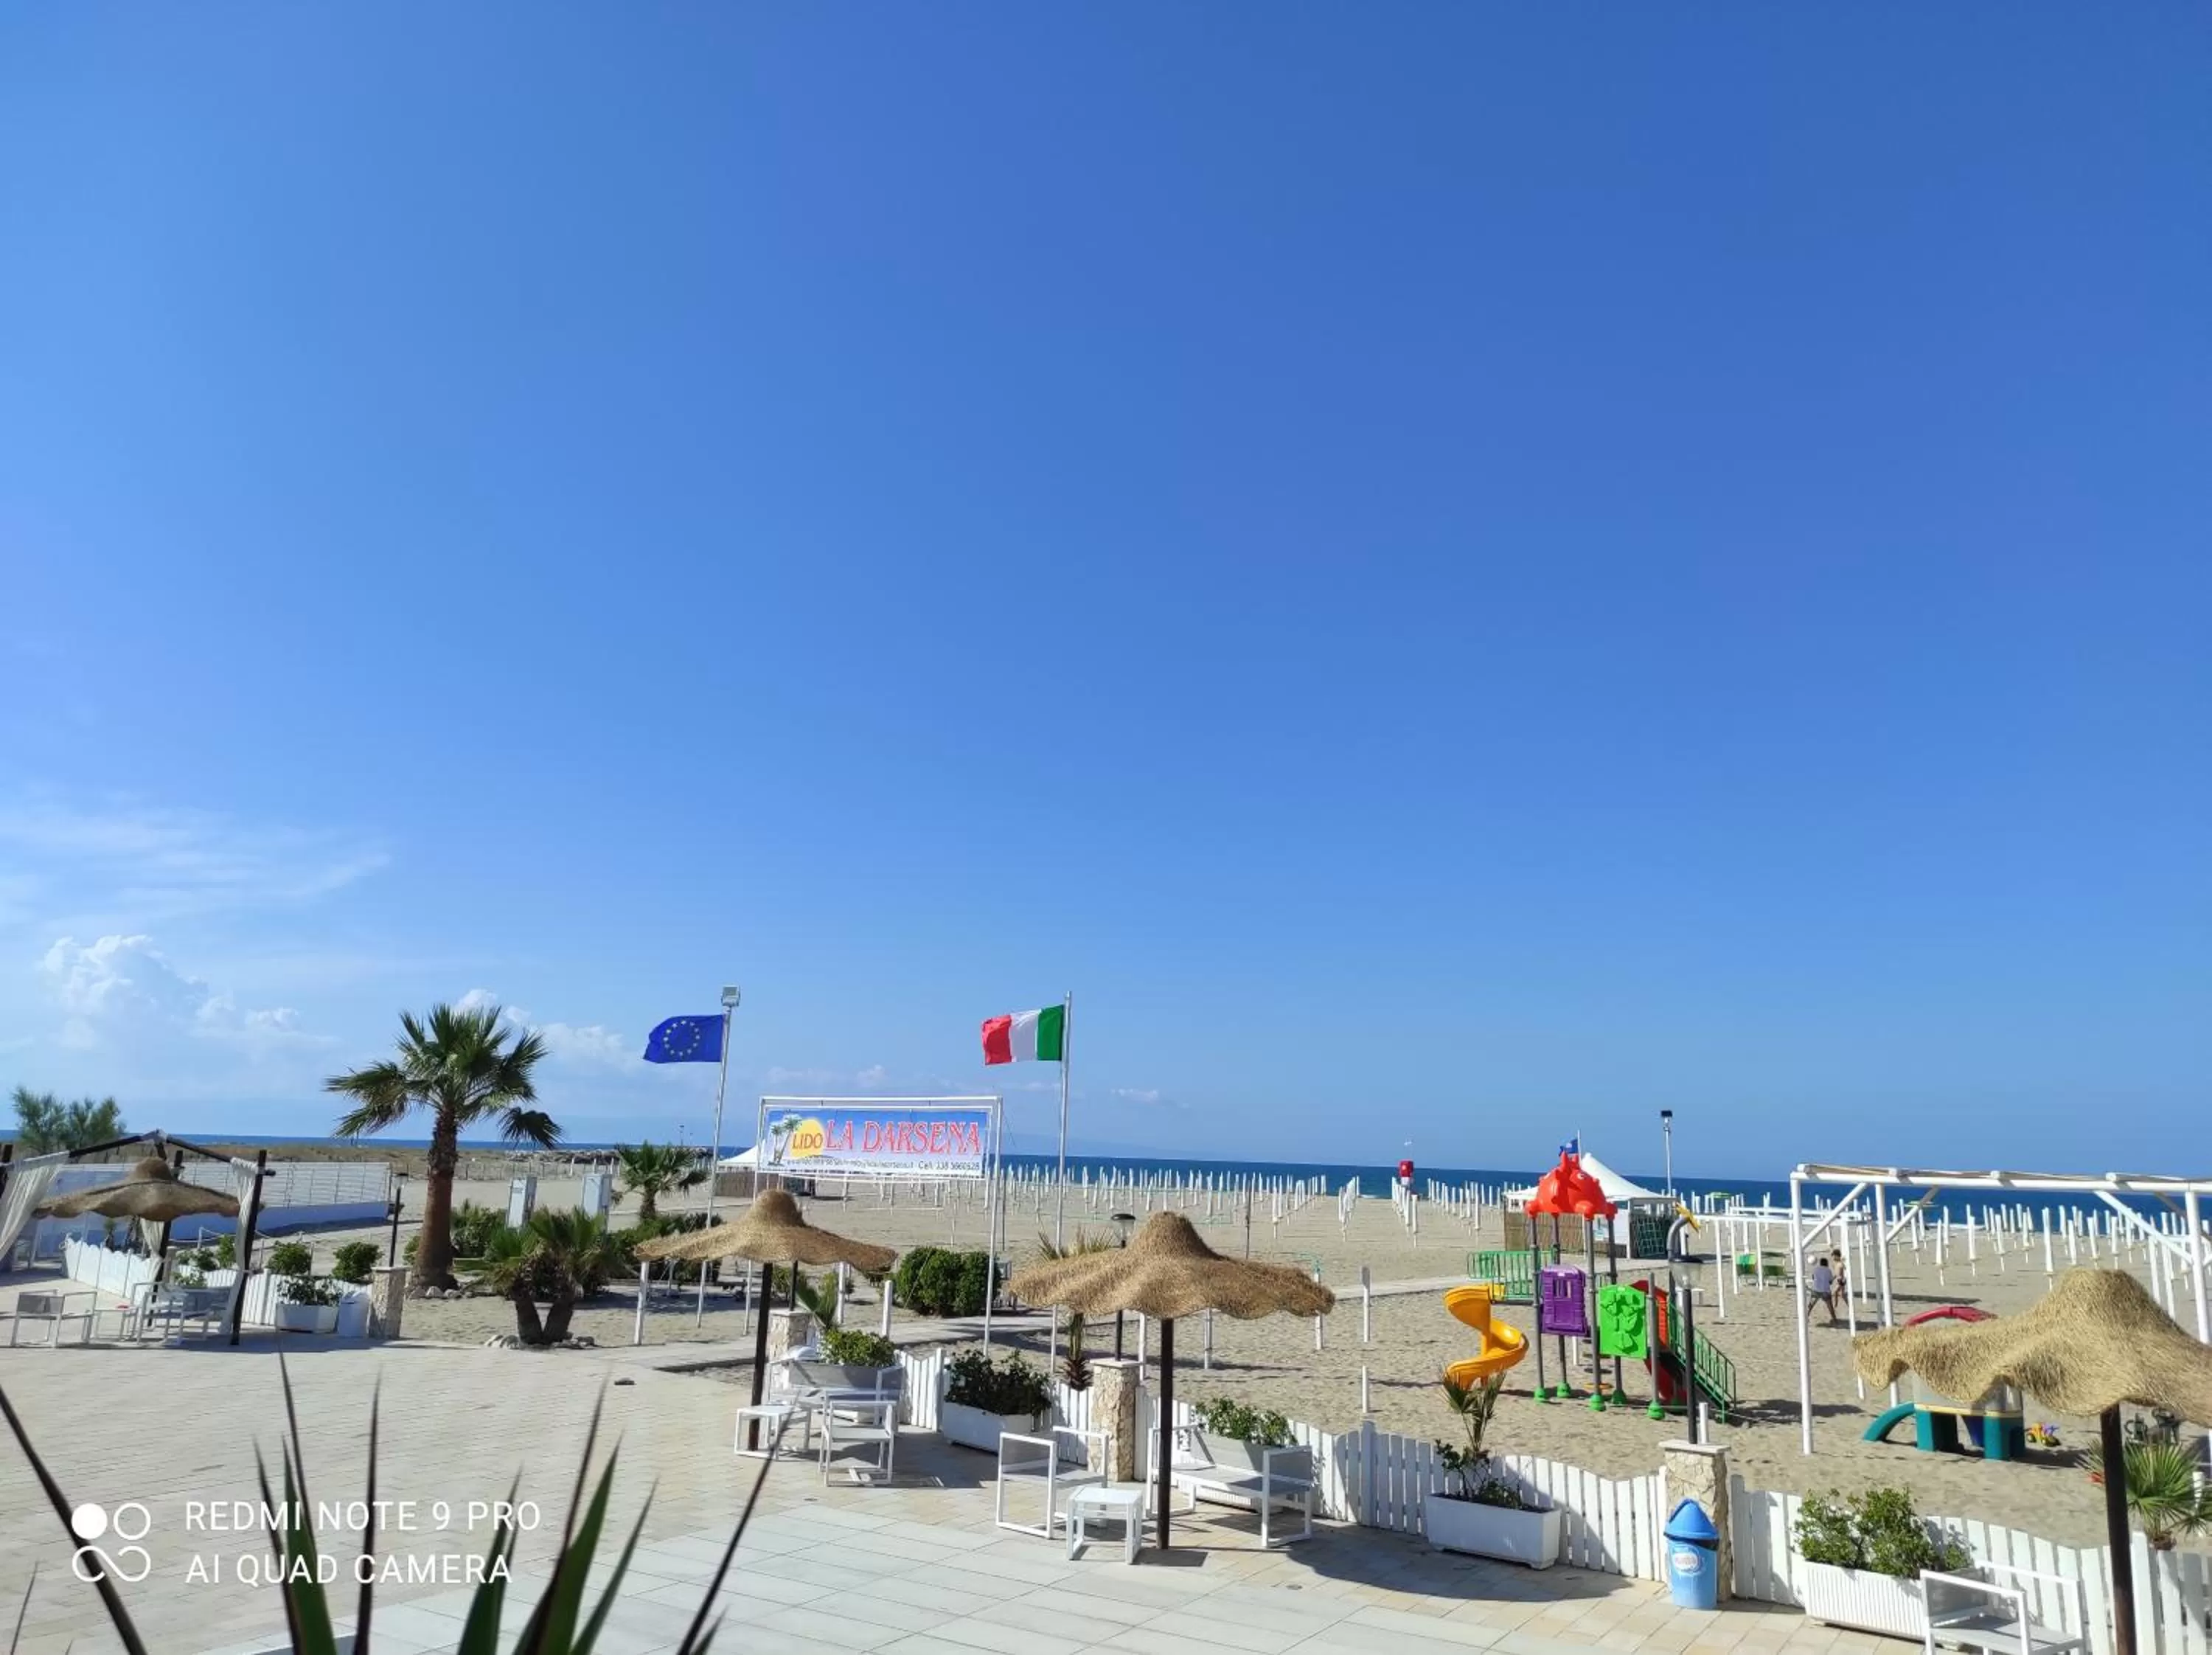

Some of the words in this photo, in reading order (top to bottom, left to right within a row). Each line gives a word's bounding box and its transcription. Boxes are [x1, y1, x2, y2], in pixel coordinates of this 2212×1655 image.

[792, 1132, 823, 1150] LIDO
[825, 1119, 853, 1151] LA
[861, 1120, 981, 1156] DARSENA
